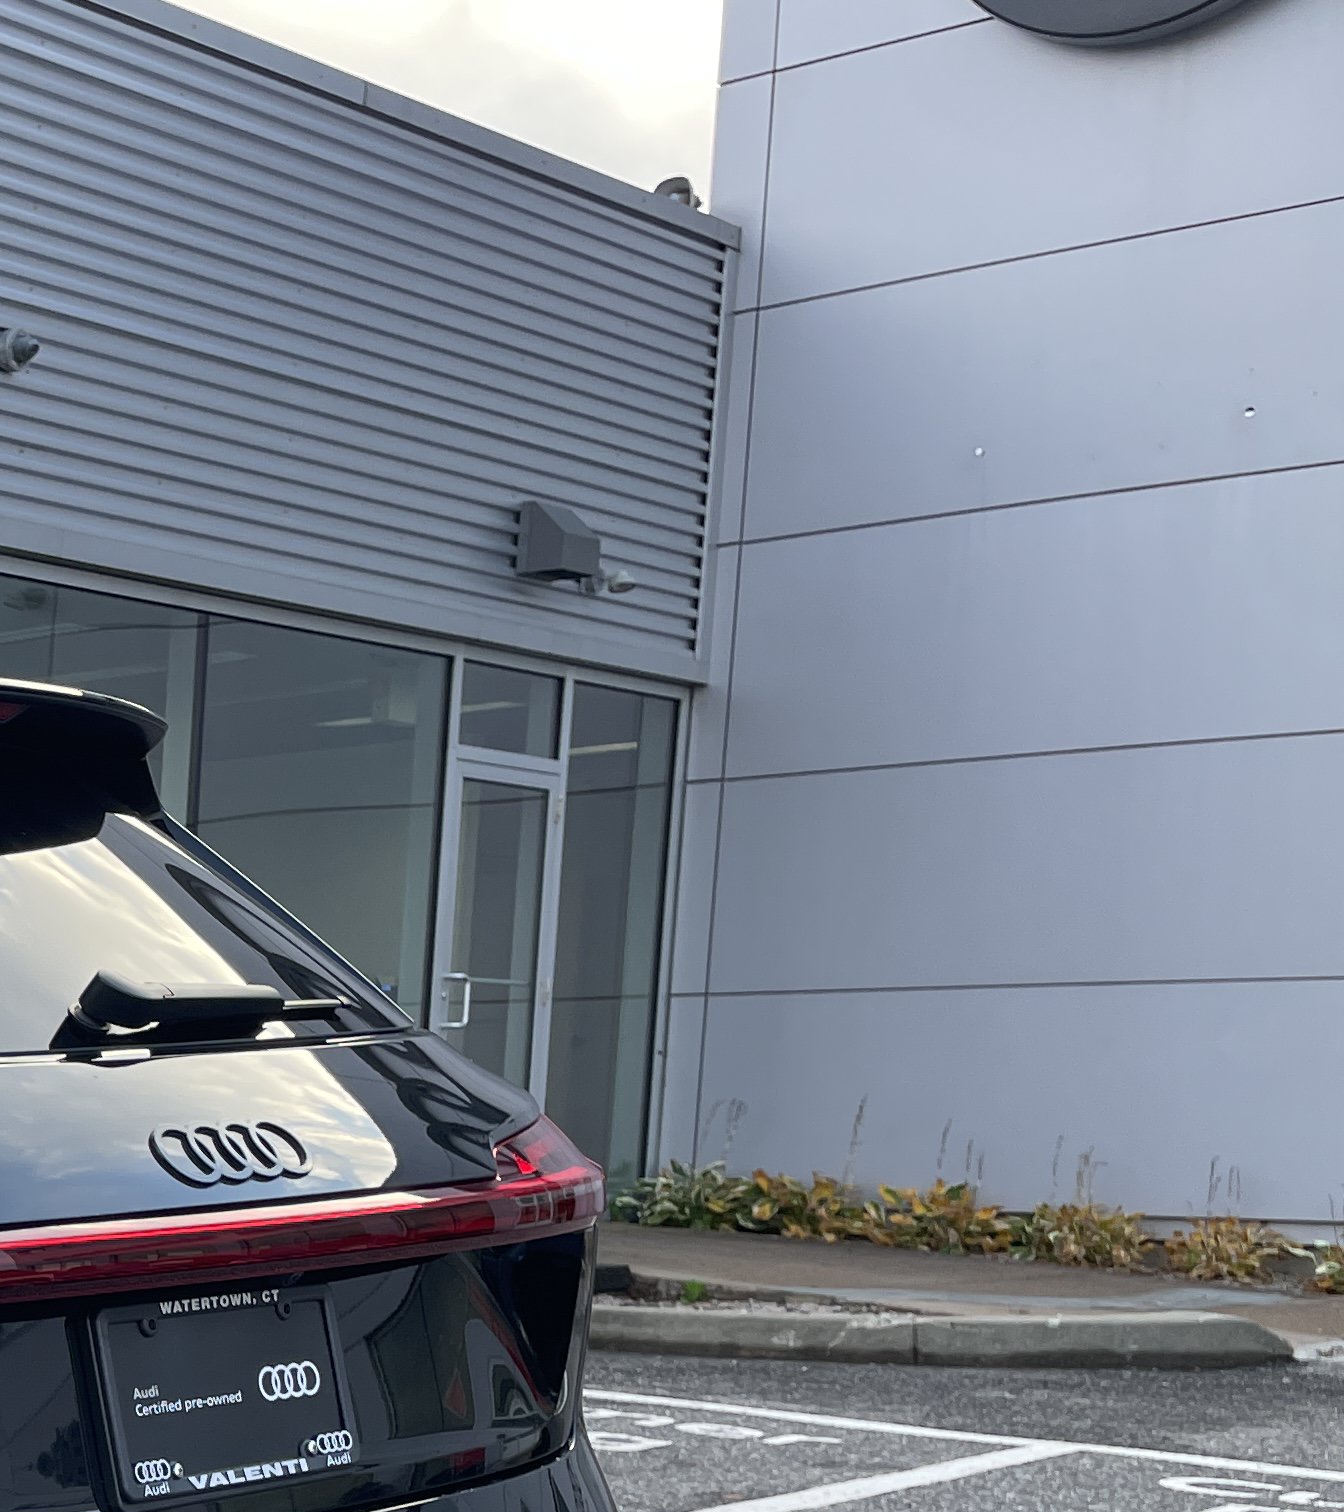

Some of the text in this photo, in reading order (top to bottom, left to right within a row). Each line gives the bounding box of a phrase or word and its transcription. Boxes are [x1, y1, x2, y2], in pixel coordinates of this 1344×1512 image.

[159, 1289, 280, 1315] WATERTOWN, CT
[133, 1385, 160, 1400] Audi
[135, 1390, 243, 1417] Certified pre-owned
[326, 1453, 352, 1467] Audi
[187, 1457, 309, 1490] VALENTI
[144, 1483, 171, 1498] Audi
